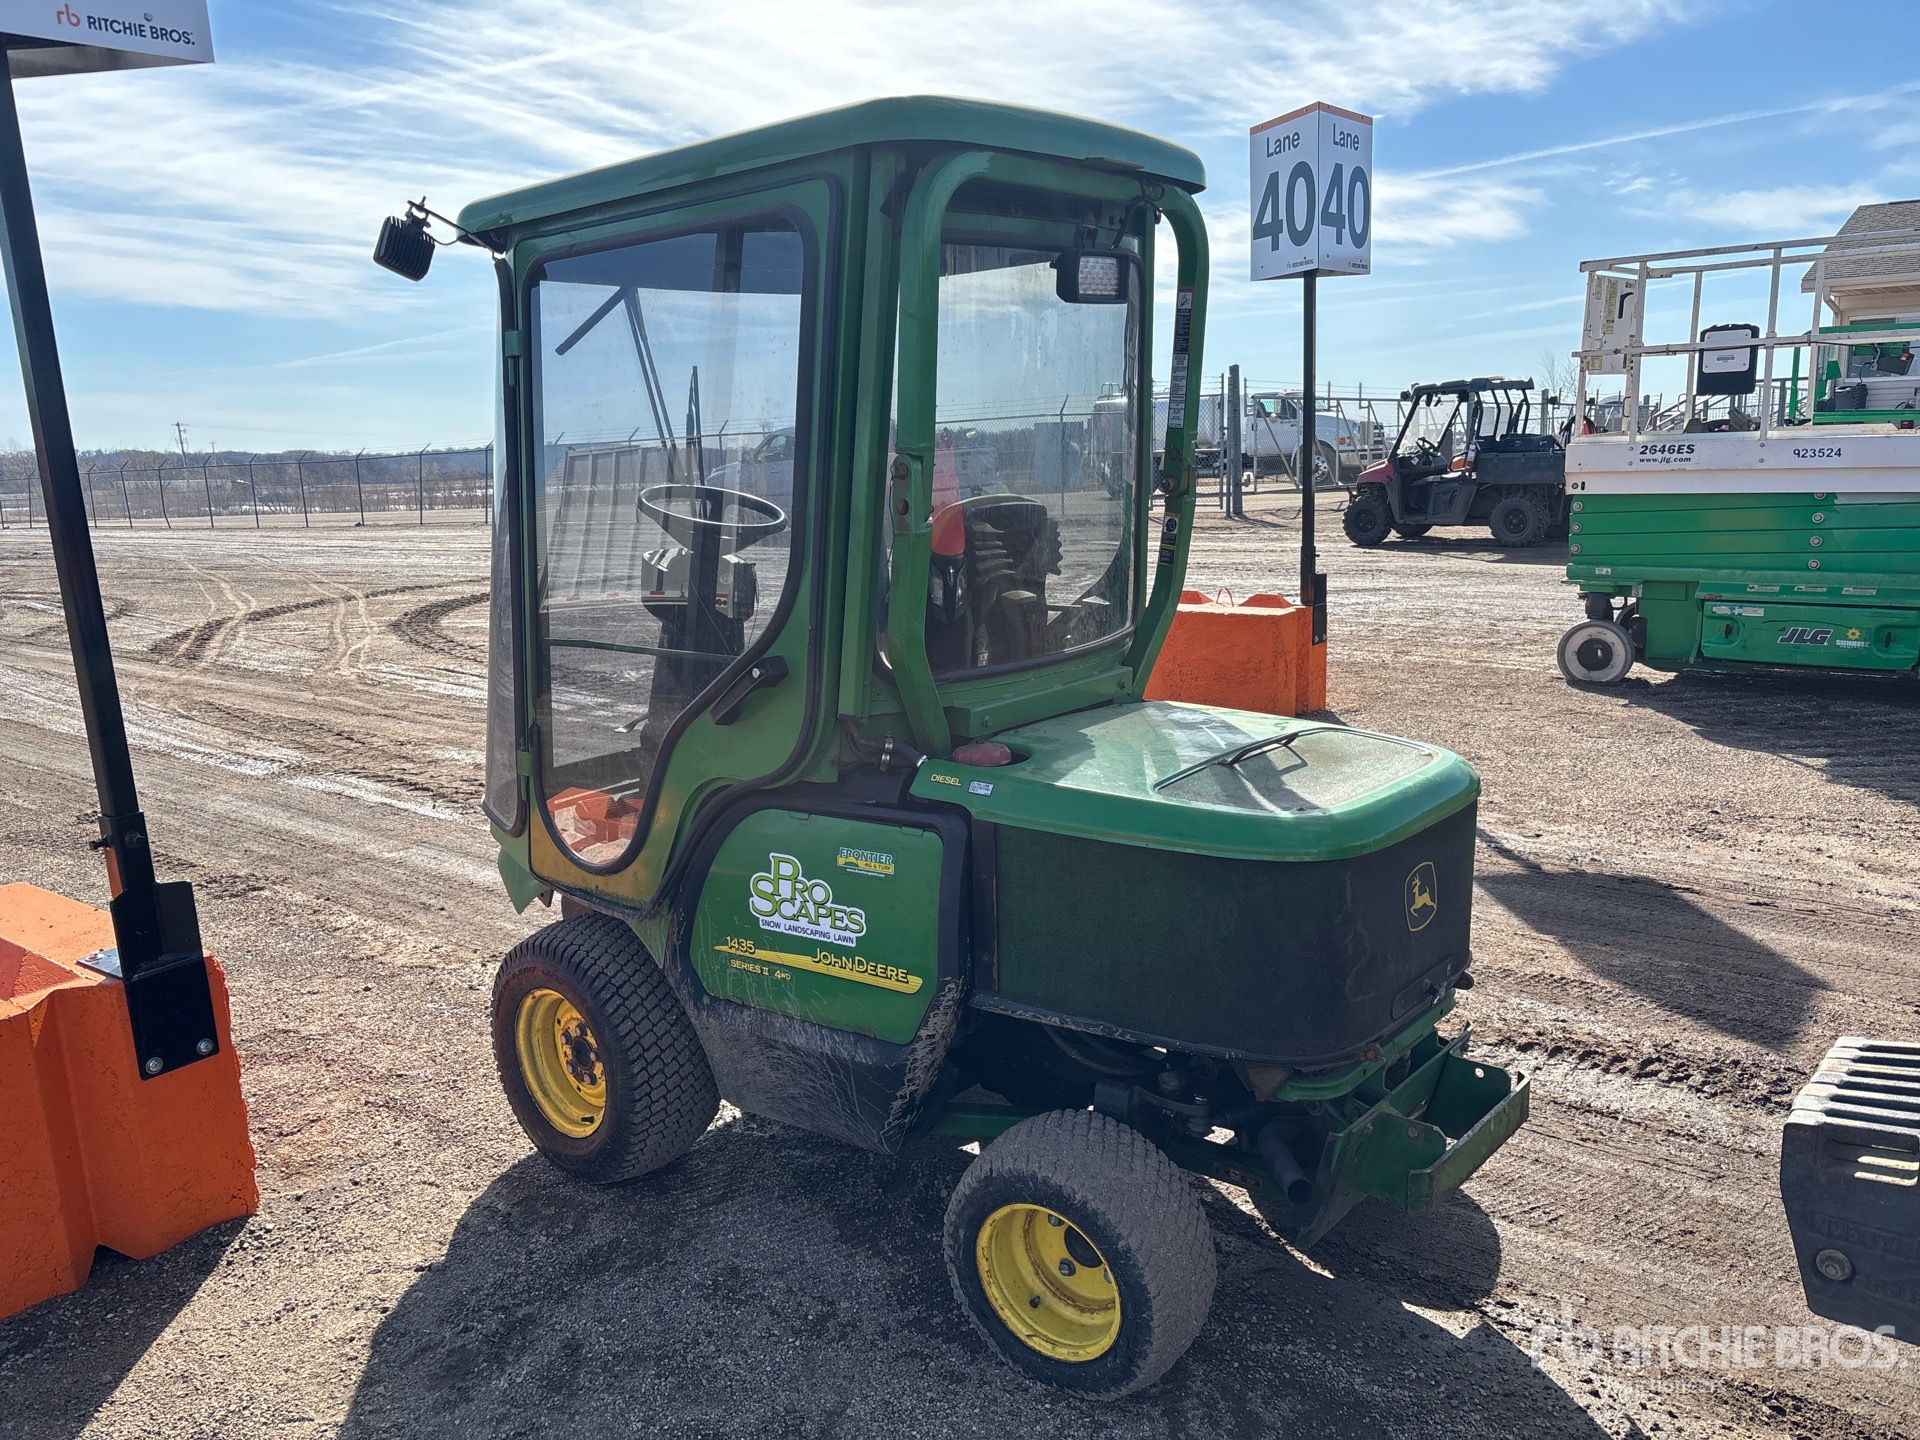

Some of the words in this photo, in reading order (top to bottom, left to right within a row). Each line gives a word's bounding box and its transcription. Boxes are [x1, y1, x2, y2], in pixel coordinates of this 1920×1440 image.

[56, 3, 81, 28] rb
[86, 15, 147, 38] RITCHIE
[149, 26, 196, 46] BROS.
[1266, 131, 1301, 159] Lane
[1332, 123, 1360, 152] Lane
[1252, 161, 1316, 252] 40
[1320, 162, 1370, 249] 40
[1639, 444, 1696, 455] 2646ES
[1639, 456, 1692, 464] www.jlg.com
[1792, 447, 1842, 459] 923524
[1777, 627, 1834, 646] JLG
[930, 773, 962, 787] DIESEL
[840, 848, 892, 864] FRONTIER
[772, 856, 831, 905] PRO
[751, 874, 865, 934] SCAPES
[761, 918, 782, 930] SNOW
[784, 923, 831, 940] LANDSCAPING
[833, 933, 855, 945] LAWN
[726, 936, 755, 954] 1435
[730, 959, 762, 974] SERIES
[774, 969, 792, 981] 4WD
[855, 956, 910, 983] DEERE
